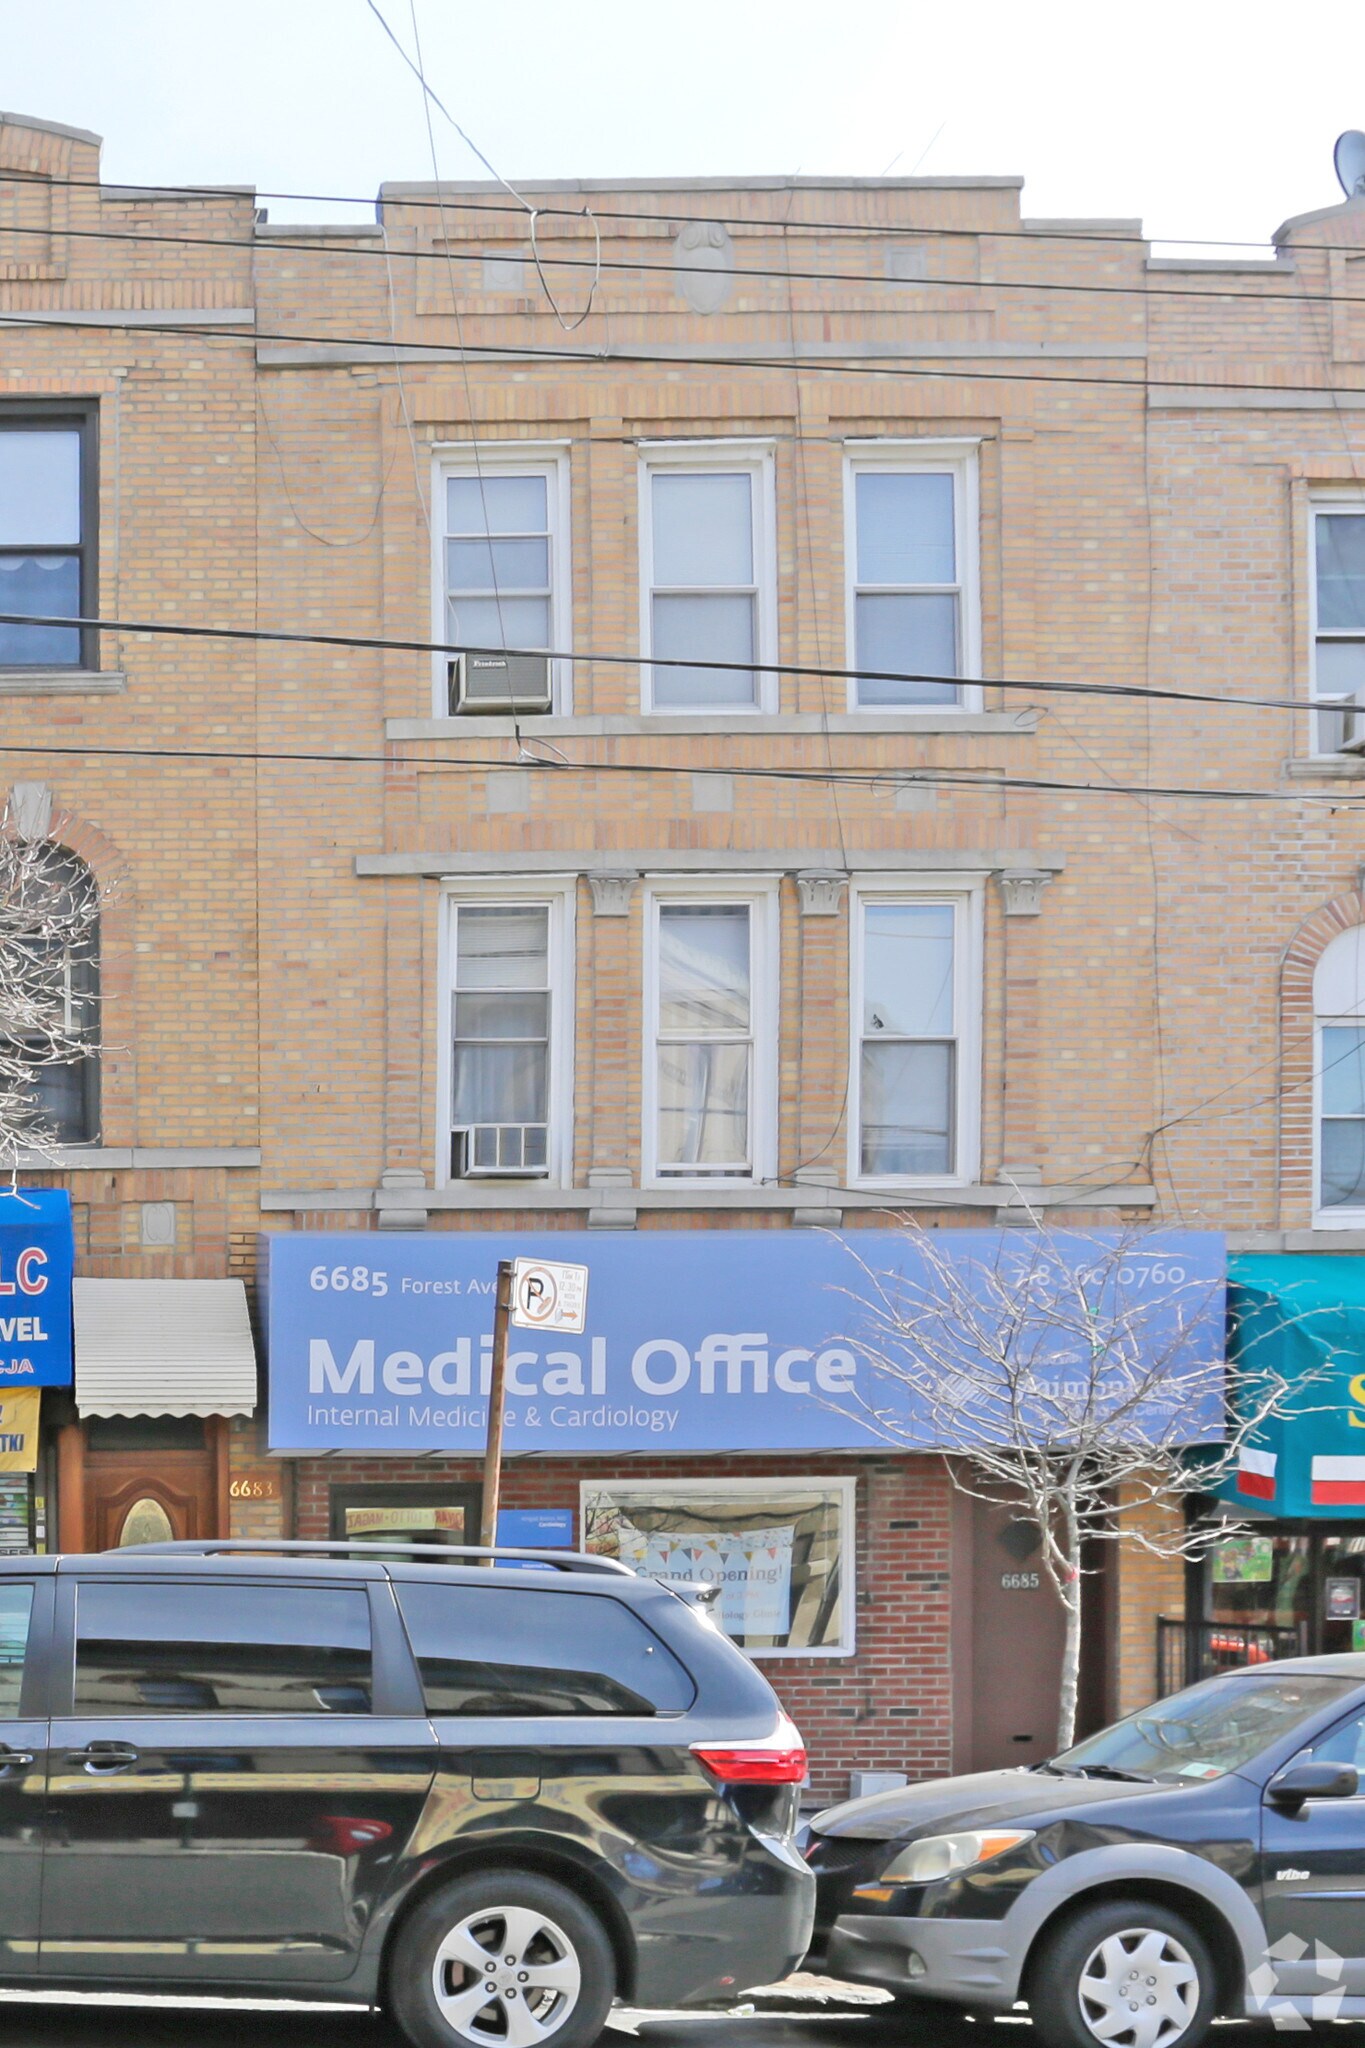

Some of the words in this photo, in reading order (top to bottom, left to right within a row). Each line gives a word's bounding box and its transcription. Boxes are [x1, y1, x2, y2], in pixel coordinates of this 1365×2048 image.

[310, 1266, 388, 1296] 6685
[401, 1276, 461, 1295] Forest
[309, 1335, 606, 1395] Medical
[631, 1333, 857, 1395] Office
[307, 1405, 399, 1426] Internal
[409, 1405, 516, 1427] Medicie
[525, 1407, 541, 1427] &
[550, 1405, 679, 1431] Cardiology
[1134, 1404, 1181, 1416] Cente
[230, 1480, 272, 1497] 6683
[635, 1566, 693, 1582] Grand
[700, 1564, 783, 1585] Opening!
[1001, 1573, 1039, 1589] 6685
